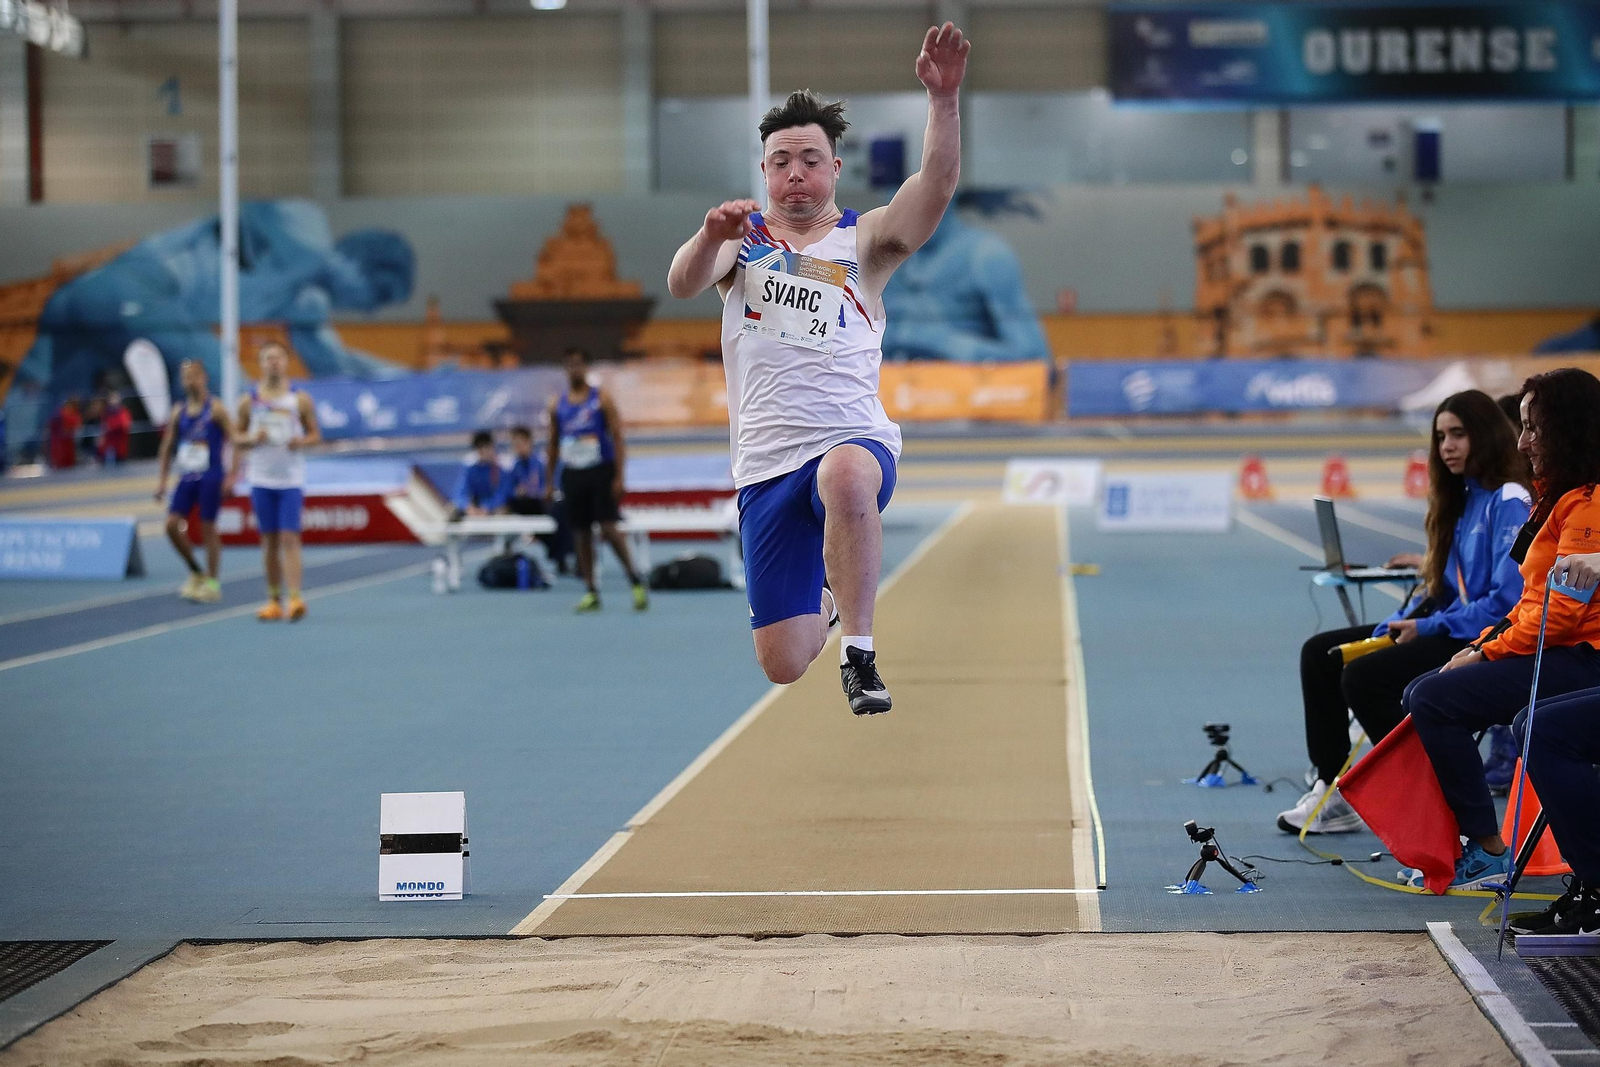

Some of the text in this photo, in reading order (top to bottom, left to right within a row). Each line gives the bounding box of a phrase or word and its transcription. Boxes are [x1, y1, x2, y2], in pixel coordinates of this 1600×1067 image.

[1304, 27, 1557, 75] OURENSE
[799, 266, 832, 277] SHORT TRACK
[818, 265, 837, 274] WORLD
[798, 271, 836, 284] CHAMPIONSHIP
[762, 275, 822, 313] ŠVARC
[809, 318, 828, 338] 24
[396, 881, 445, 891] MONDO
